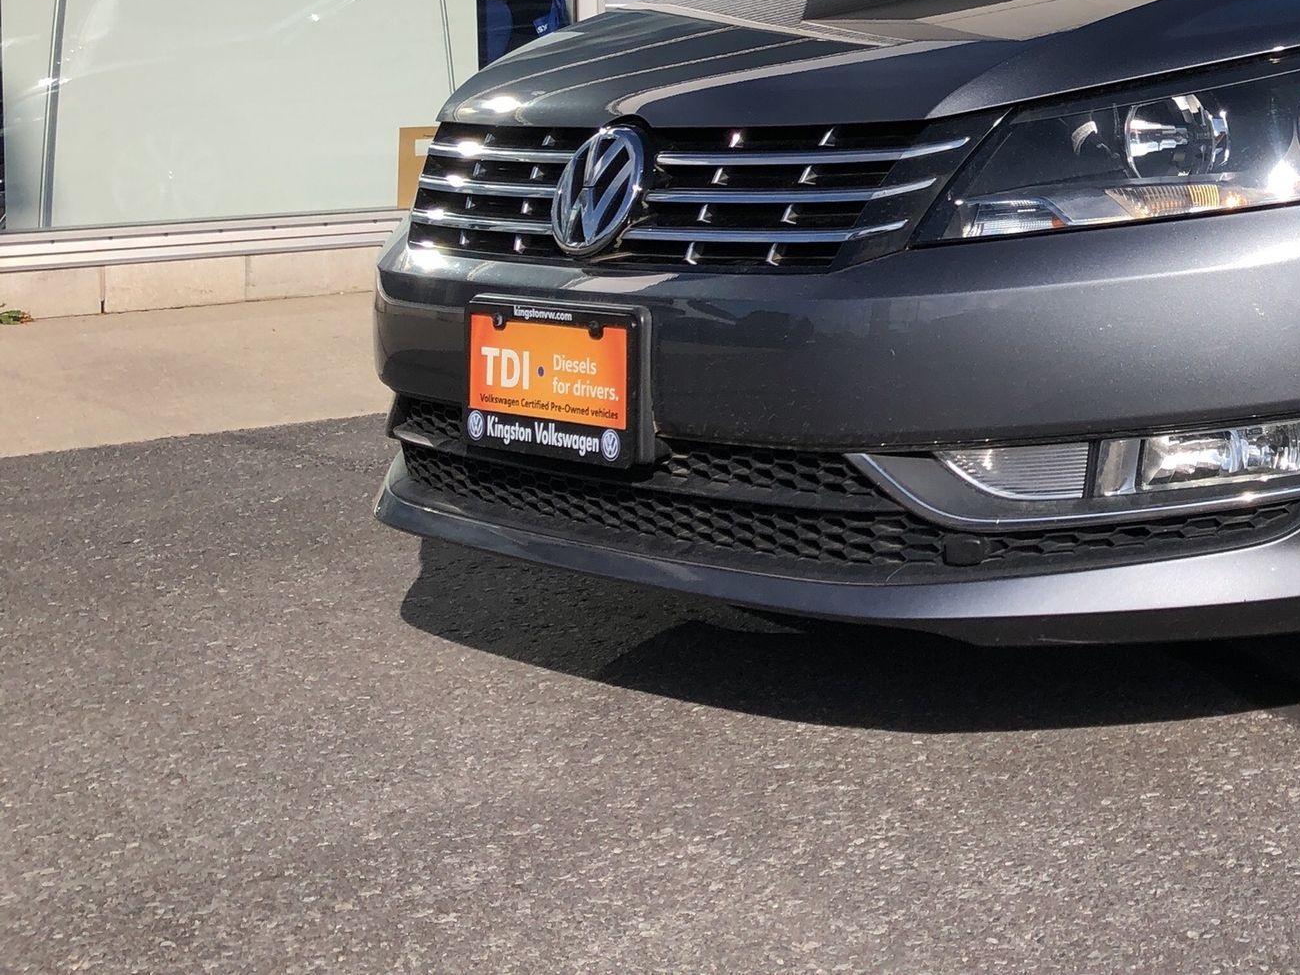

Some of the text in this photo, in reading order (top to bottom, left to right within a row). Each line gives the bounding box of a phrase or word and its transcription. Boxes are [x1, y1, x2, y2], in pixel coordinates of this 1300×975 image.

[513, 305, 572, 321] kingstonvw.com
[481, 346, 530, 390] TDI
[553, 354, 597, 375] Diesels
[552, 377, 619, 401] for drivers.
[480, 393, 618, 420] Volkswagen Certified Pre-Owned vehicles
[486, 415, 532, 445] Kingston
[534, 421, 600, 456] Volkswagen
